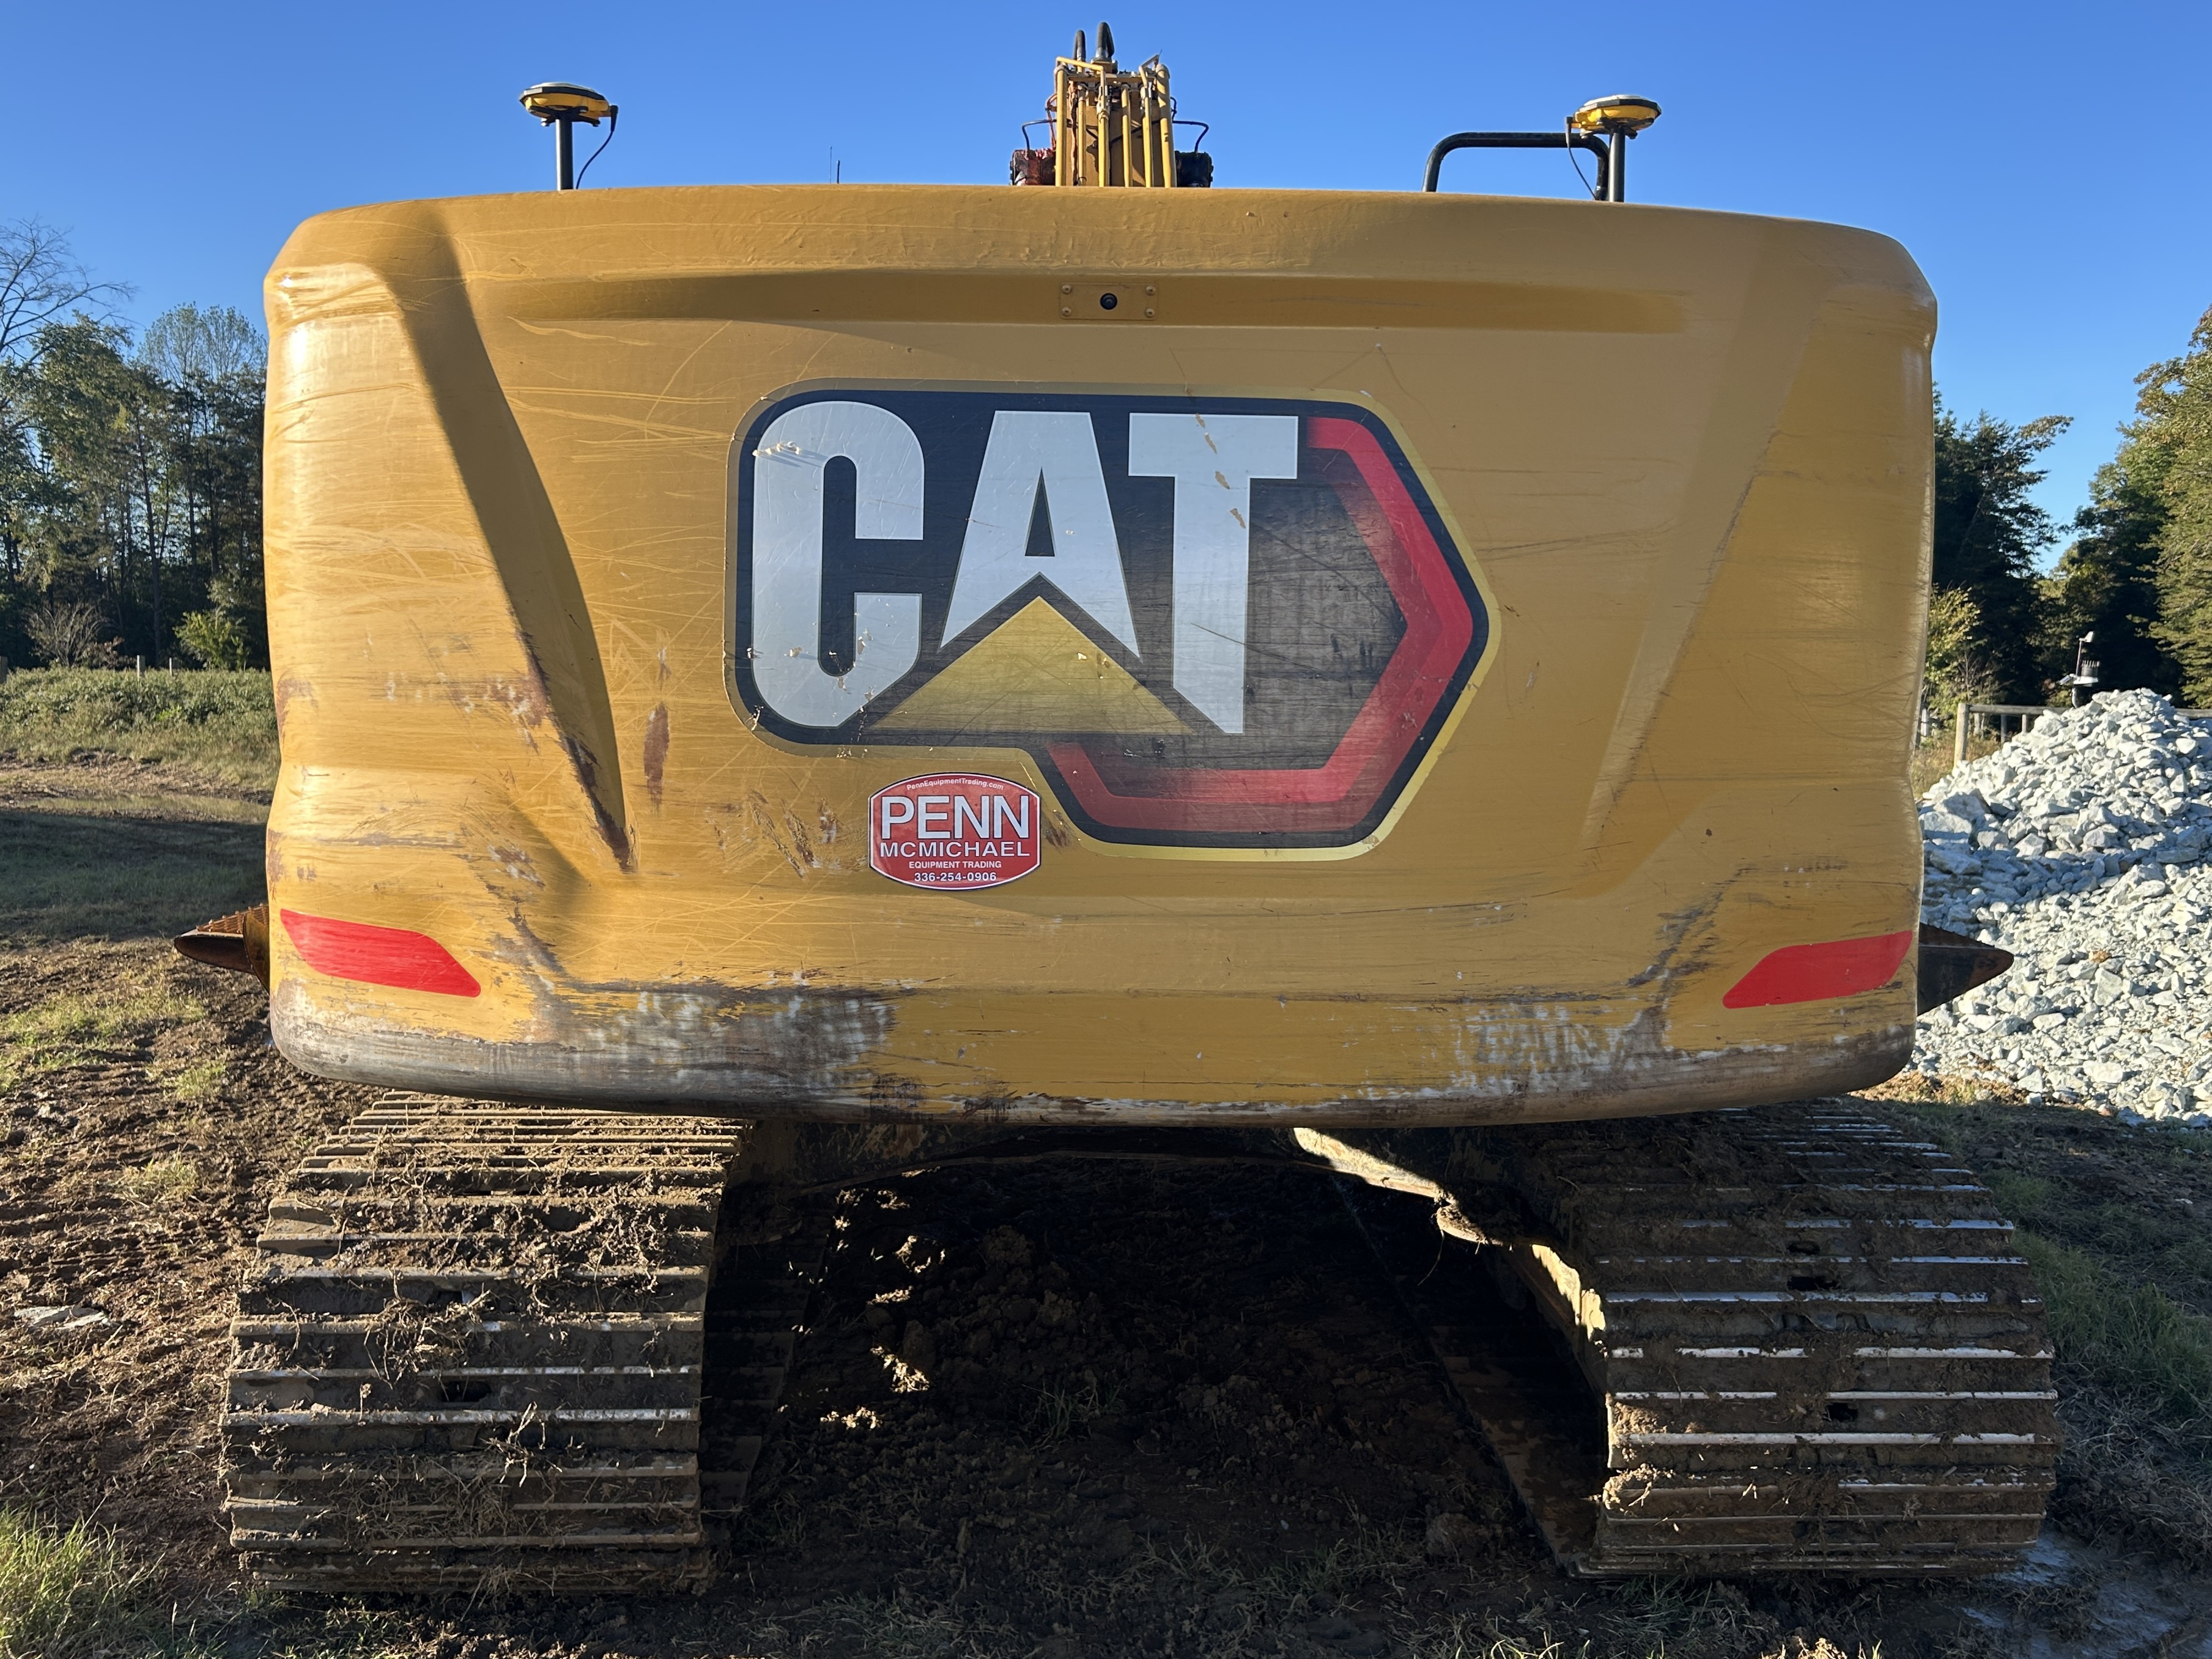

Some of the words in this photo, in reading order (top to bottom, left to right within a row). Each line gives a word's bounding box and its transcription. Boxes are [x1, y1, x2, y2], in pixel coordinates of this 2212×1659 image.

[752, 400, 1298, 734] CAT
[906, 778, 1004, 791] PennEquipmentTrading.com
[881, 795, 1030, 840] PENN
[879, 841, 1030, 857] MCMICHAEL
[914, 872, 997, 882] 336-254-0906
